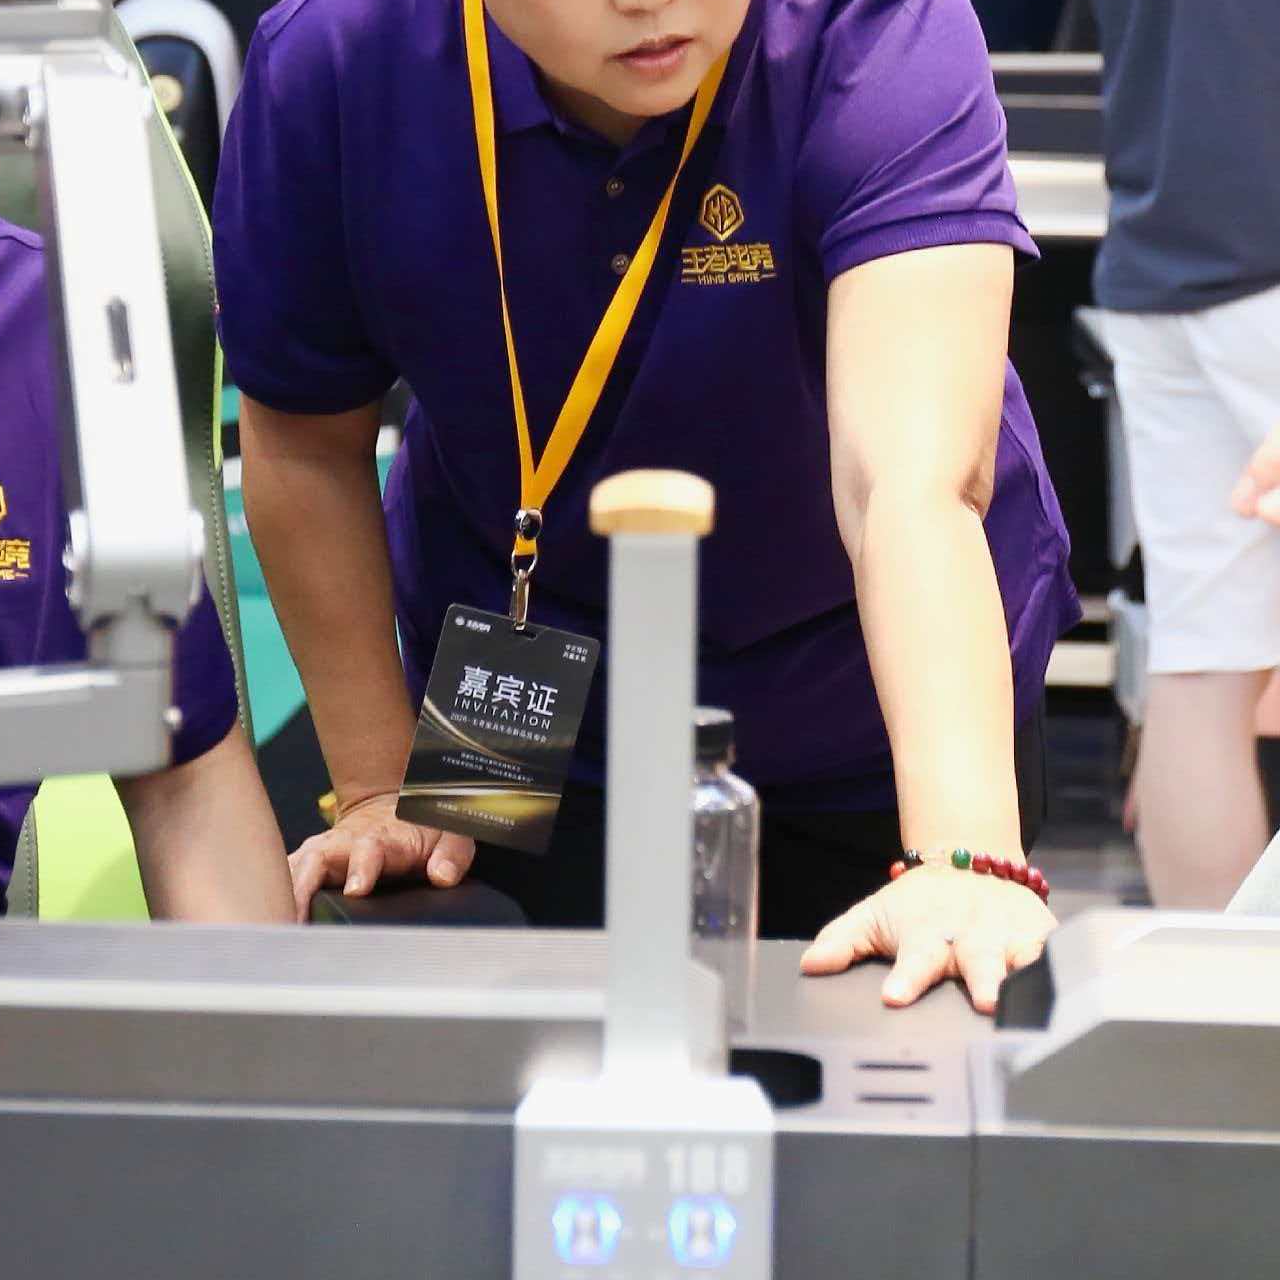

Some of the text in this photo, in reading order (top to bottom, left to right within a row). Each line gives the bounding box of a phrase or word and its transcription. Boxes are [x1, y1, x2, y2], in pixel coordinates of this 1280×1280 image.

[456, 664, 559, 716] 嘉宾证
[453, 696, 552, 731] INVITATION
